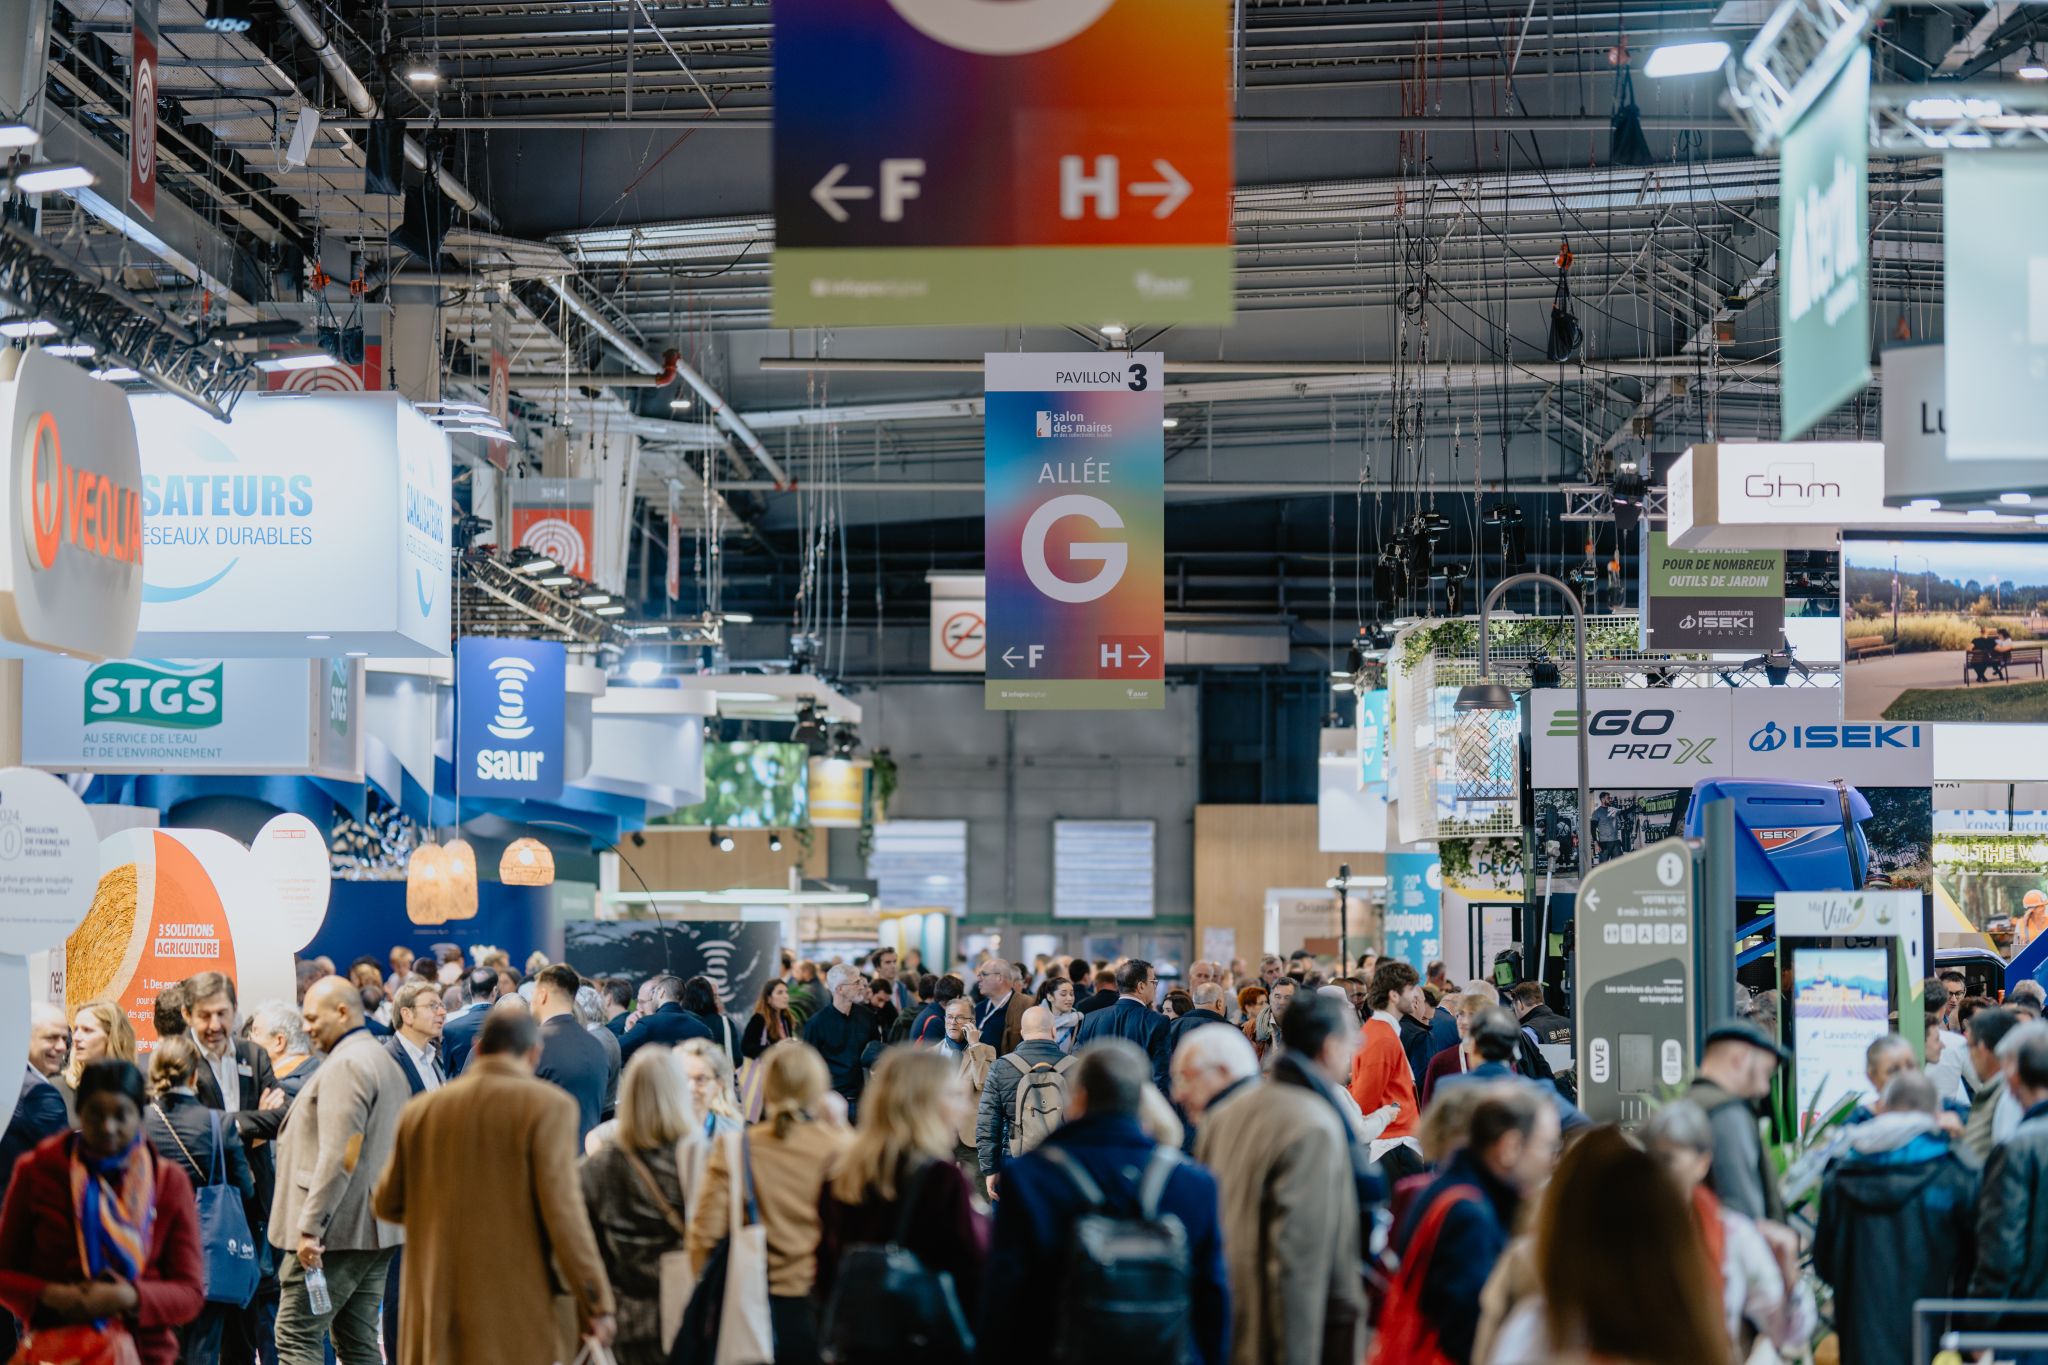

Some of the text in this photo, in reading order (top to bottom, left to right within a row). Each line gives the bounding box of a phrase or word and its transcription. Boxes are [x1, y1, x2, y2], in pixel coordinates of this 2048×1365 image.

[880, 157, 926, 222] F
[1060, 154, 1119, 220] H
[1056, 363, 1148, 391] PAVILLON 3
[1053, 411, 1084, 422] salon
[1053, 422, 1112, 433] des maires
[1038, 457, 1111, 484] ALLÉE
[143, 474, 313, 517] SATEURS
[1745, 475, 1840, 498] Ghm
[66, 464, 143, 566] VEOLIA
[216, 527, 312, 545] DURABLES
[1021, 494, 1128, 604] G
[1662, 559, 1776, 571] POUR DE NOMBREUX
[1669, 575, 1769, 588] OUTILS DE JARDIN
[1698, 617, 1753, 628] ISEKI
[1029, 644, 1045, 668] F
[1101, 643, 1122, 668] H
[90, 678, 217, 714] STGS
[84, 733, 197, 744] AU SERVICE DE L'EAU
[1794, 725, 1920, 748] ISEKI
[82, 747, 222, 759] ET DE L'ENVIRONNEMENT
[477, 749, 544, 781] saur
[1760, 831, 1797, 840] ISEKI
[1968, 821, 2048, 830] CONSTUCTI
[159, 924, 214, 937] 3 SOLUTIONS
[157, 943, 217, 955] AGRICULTURE
[1595, 1044, 1605, 1076] LIVE
